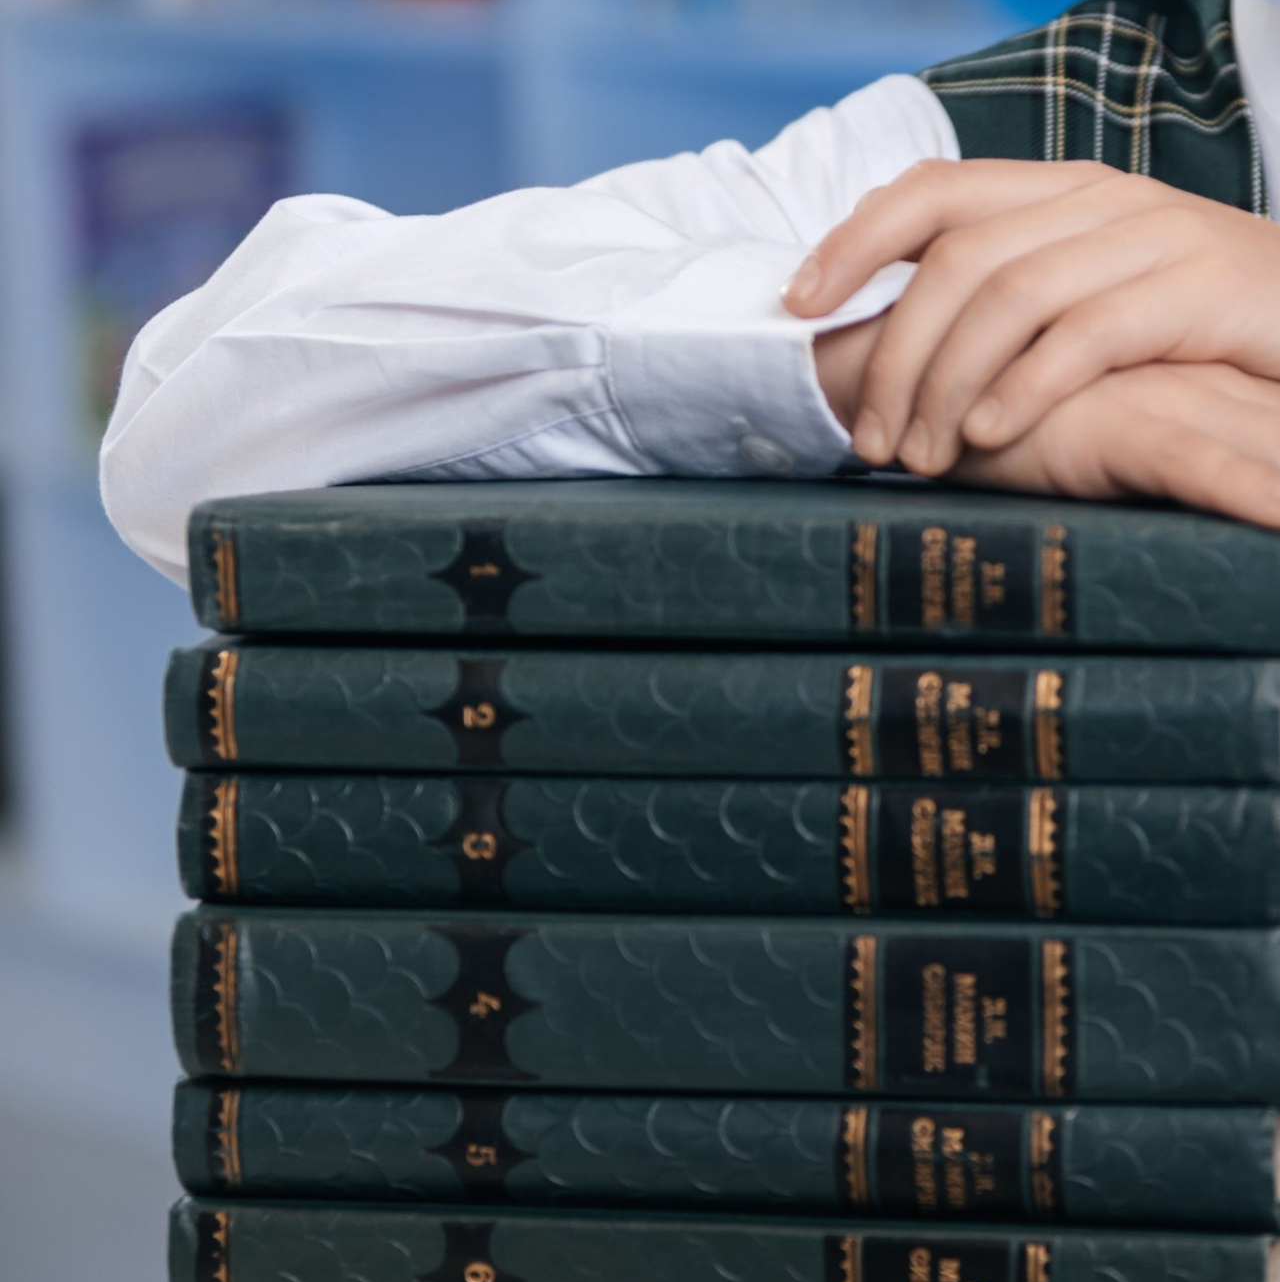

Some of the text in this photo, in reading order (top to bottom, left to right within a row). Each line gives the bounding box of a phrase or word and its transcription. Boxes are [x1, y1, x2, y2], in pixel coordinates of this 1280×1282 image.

[470, 562, 501, 577] 1
[462, 702, 496, 728] 2
[462, 831, 497, 860] 3
[469, 991, 502, 1016] 4
[466, 1144, 498, 1166] 5
